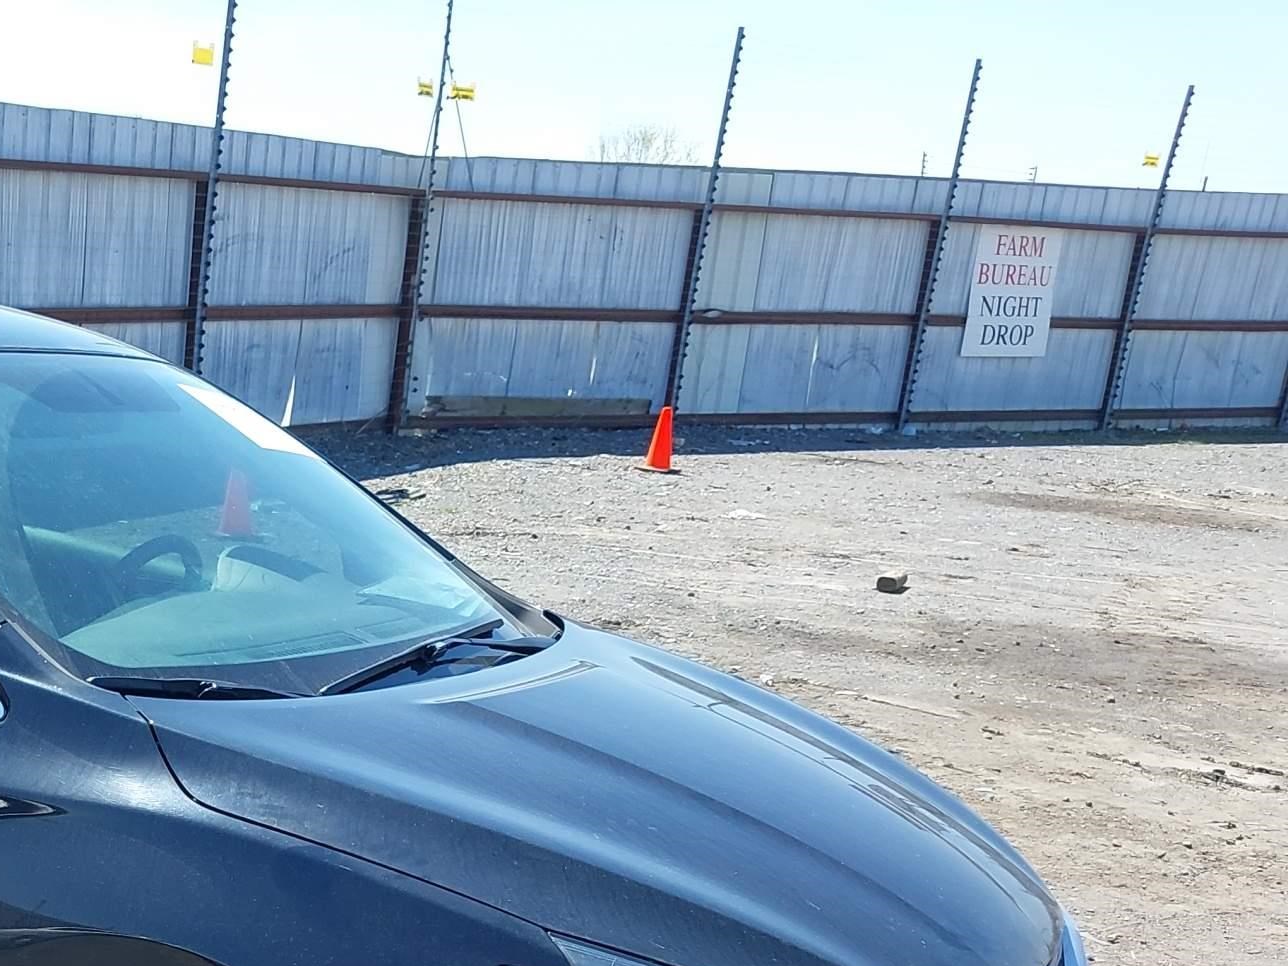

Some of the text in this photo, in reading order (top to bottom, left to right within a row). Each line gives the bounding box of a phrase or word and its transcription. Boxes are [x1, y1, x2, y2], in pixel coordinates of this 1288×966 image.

[995, 234, 1046, 257] FARM
[977, 263, 1052, 286] BUREAU
[980, 296, 1042, 317] NIGHT
[979, 325, 1034, 345] DROP
